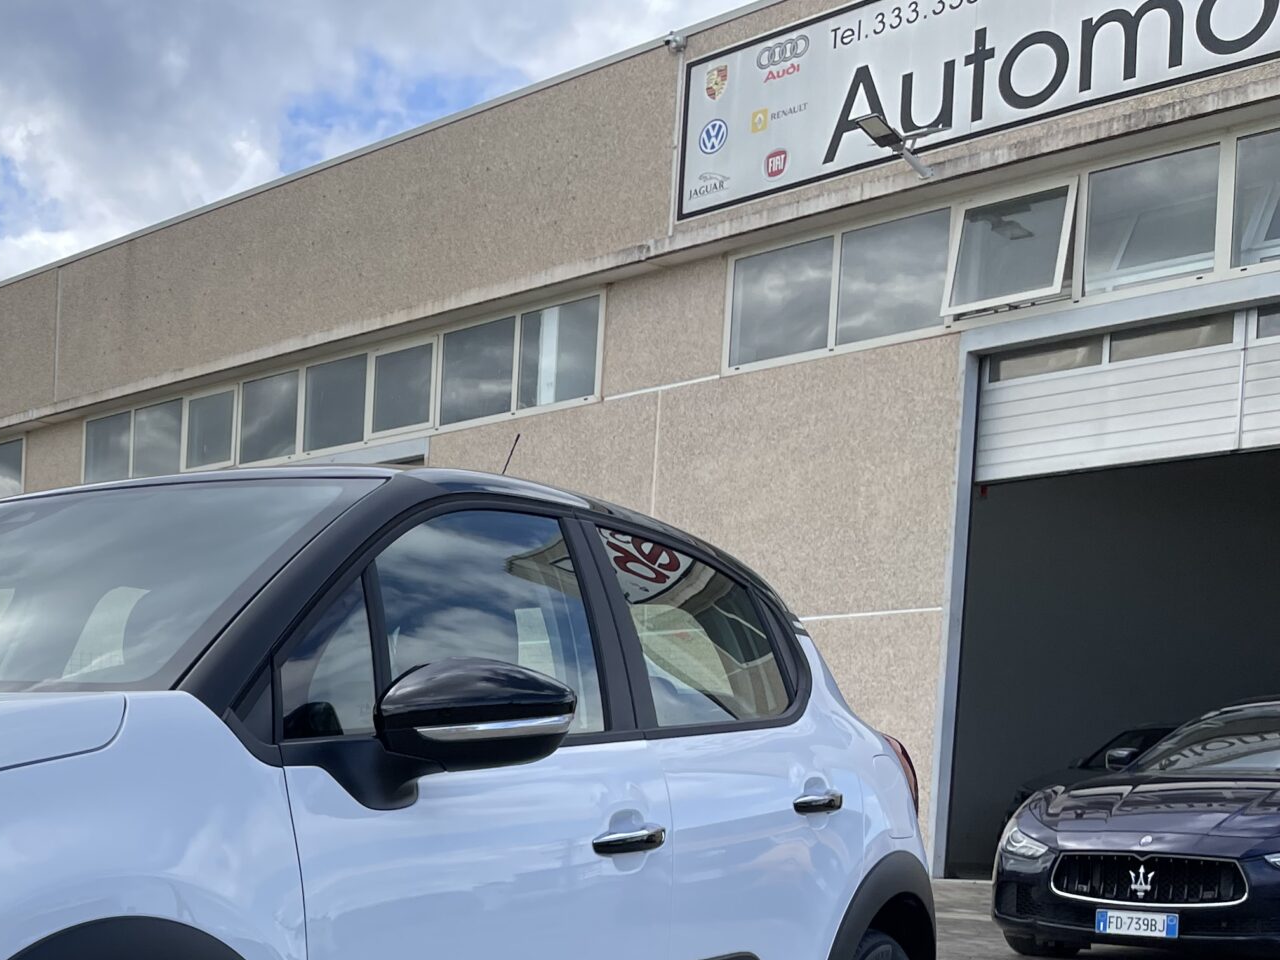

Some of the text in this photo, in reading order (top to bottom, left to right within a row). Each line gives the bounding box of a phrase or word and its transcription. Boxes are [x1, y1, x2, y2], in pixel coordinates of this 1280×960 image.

[763, 63, 800, 83] Audi
[770, 103, 808, 120] RENAULT
[768, 154, 785, 173] FIAT
[689, 180, 725, 200] JAGUAR
